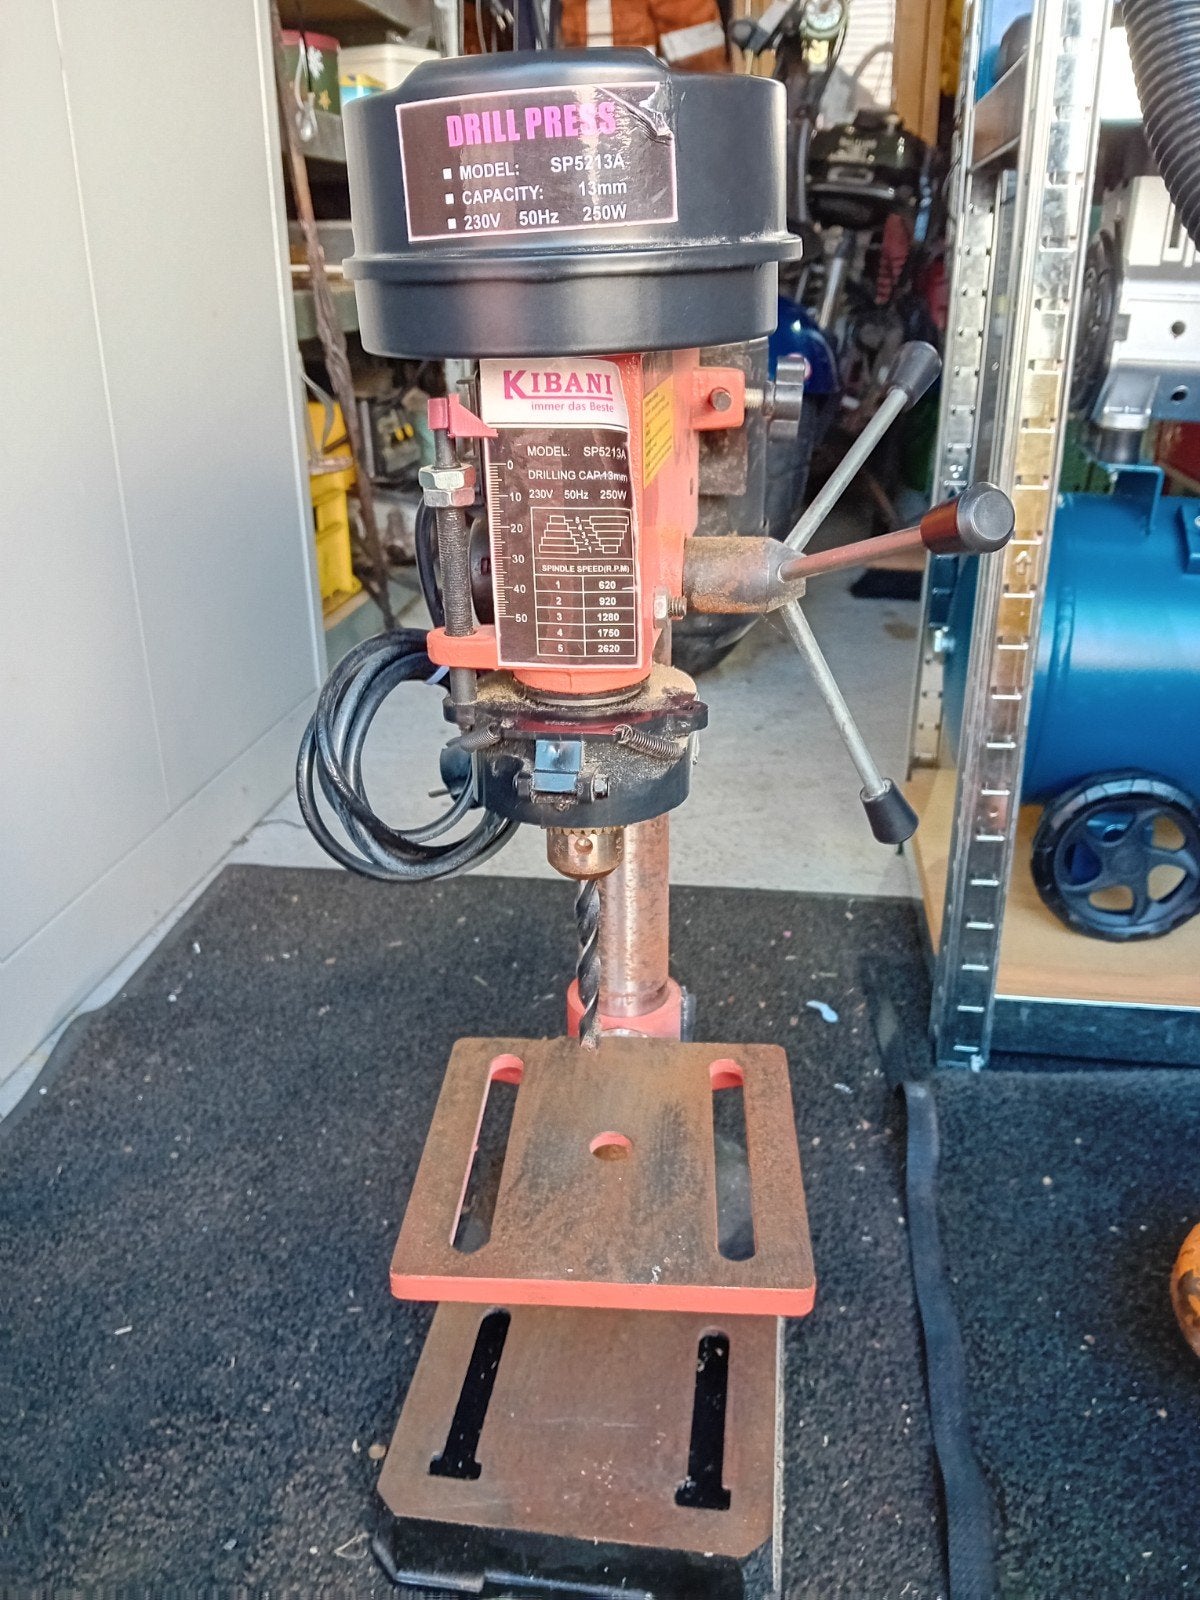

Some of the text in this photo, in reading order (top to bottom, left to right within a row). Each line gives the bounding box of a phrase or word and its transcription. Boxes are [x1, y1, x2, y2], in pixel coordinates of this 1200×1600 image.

[446, 102, 618, 148] DRILL PRESS
[460, 154, 625, 180] MODEL: SP5213A
[462, 180, 627, 205] CAPACITY: 13mm
[464, 204, 627, 231] 230V 50Hz 250W
[503, 370, 613, 400] KIBANI
[531, 402, 614, 412] immer das Beste
[527, 446, 627, 460] MODEL: SP5213A
[507, 461, 513, 470] 0
[528, 470, 576, 480] DRILLING
[510, 493, 522, 501] 10
[529, 490, 627, 500] 230V 50Hz 250W
[510, 524, 523, 533] 20
[512, 555, 525, 563] 30
[513, 585, 526, 593] 40
[555, 581, 616, 590] 1 620
[556, 597, 616, 605] 2 920
[515, 614, 527, 623] 50
[557, 613, 620, 621] 3 1280
[557, 629, 620, 637] 4 1750
[558, 644, 620, 653] 5 2620
